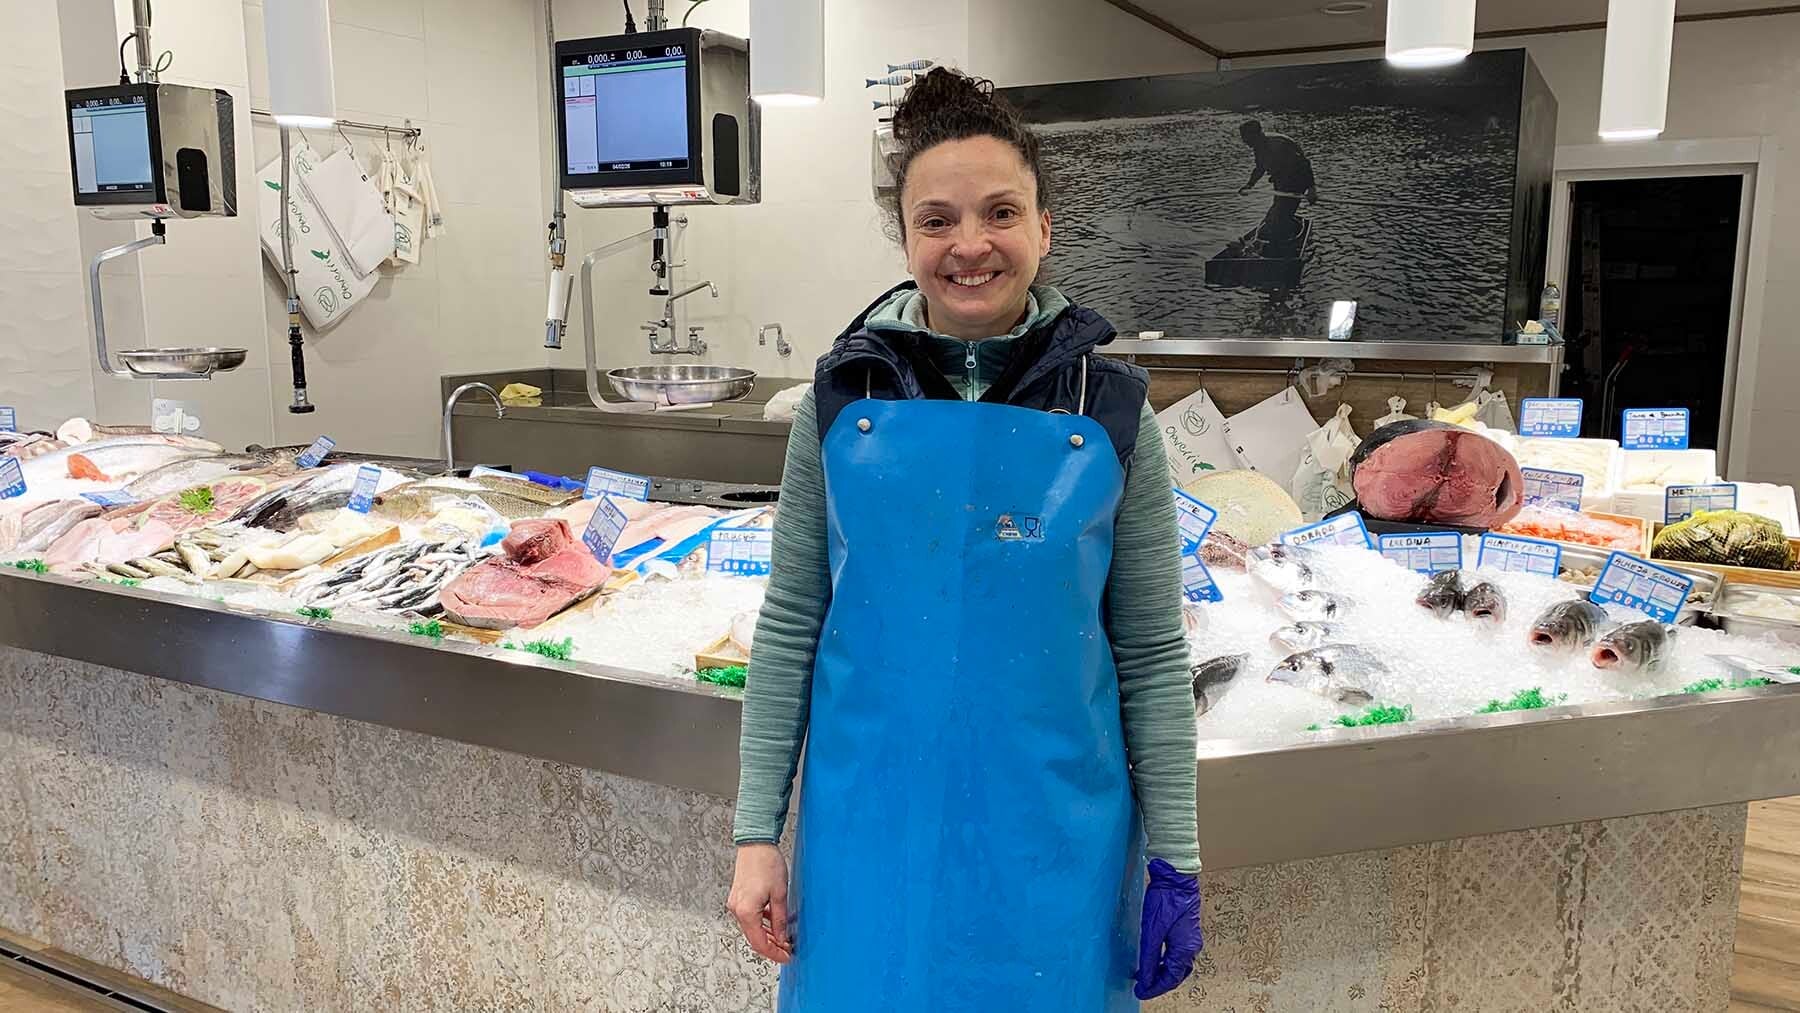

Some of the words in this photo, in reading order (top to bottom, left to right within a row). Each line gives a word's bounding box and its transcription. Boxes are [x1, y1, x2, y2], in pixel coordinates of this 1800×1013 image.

[588, 53, 608, 64] 0,000
[626, 49, 643, 61] 0,00
[665, 45, 682, 57] 0,00
